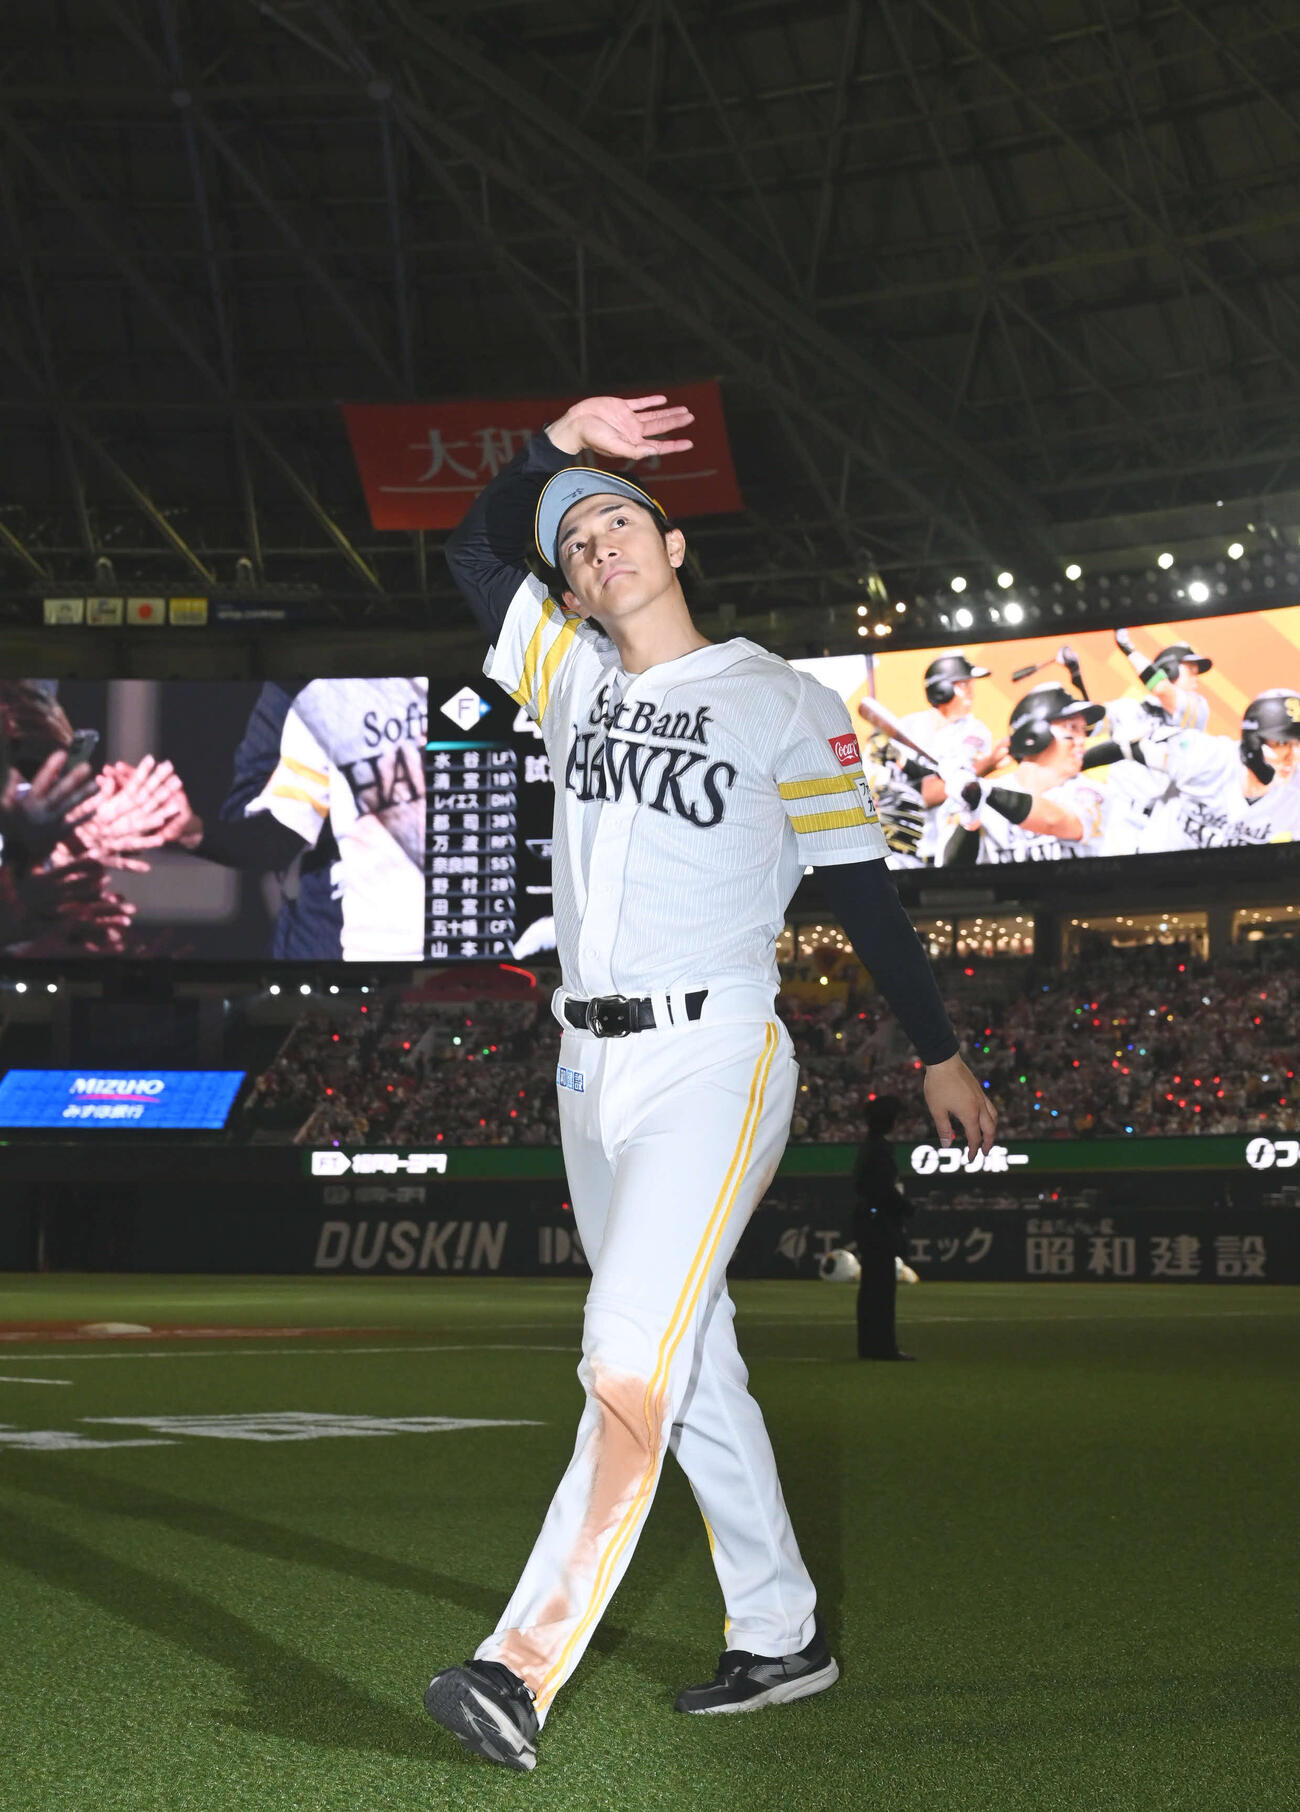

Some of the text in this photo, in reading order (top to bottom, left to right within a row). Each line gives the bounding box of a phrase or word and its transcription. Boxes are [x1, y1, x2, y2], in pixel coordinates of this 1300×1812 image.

[589, 684, 714, 746] StBank
[434, 793, 480, 810] レイエス
[493, 899, 505, 913] C
[493, 941, 505, 956] P
[68, 1078, 165, 1095] MIZUHO
[813, 1226, 994, 1264] エェック
[1025, 1234, 1266, 1277] 昭和建設
